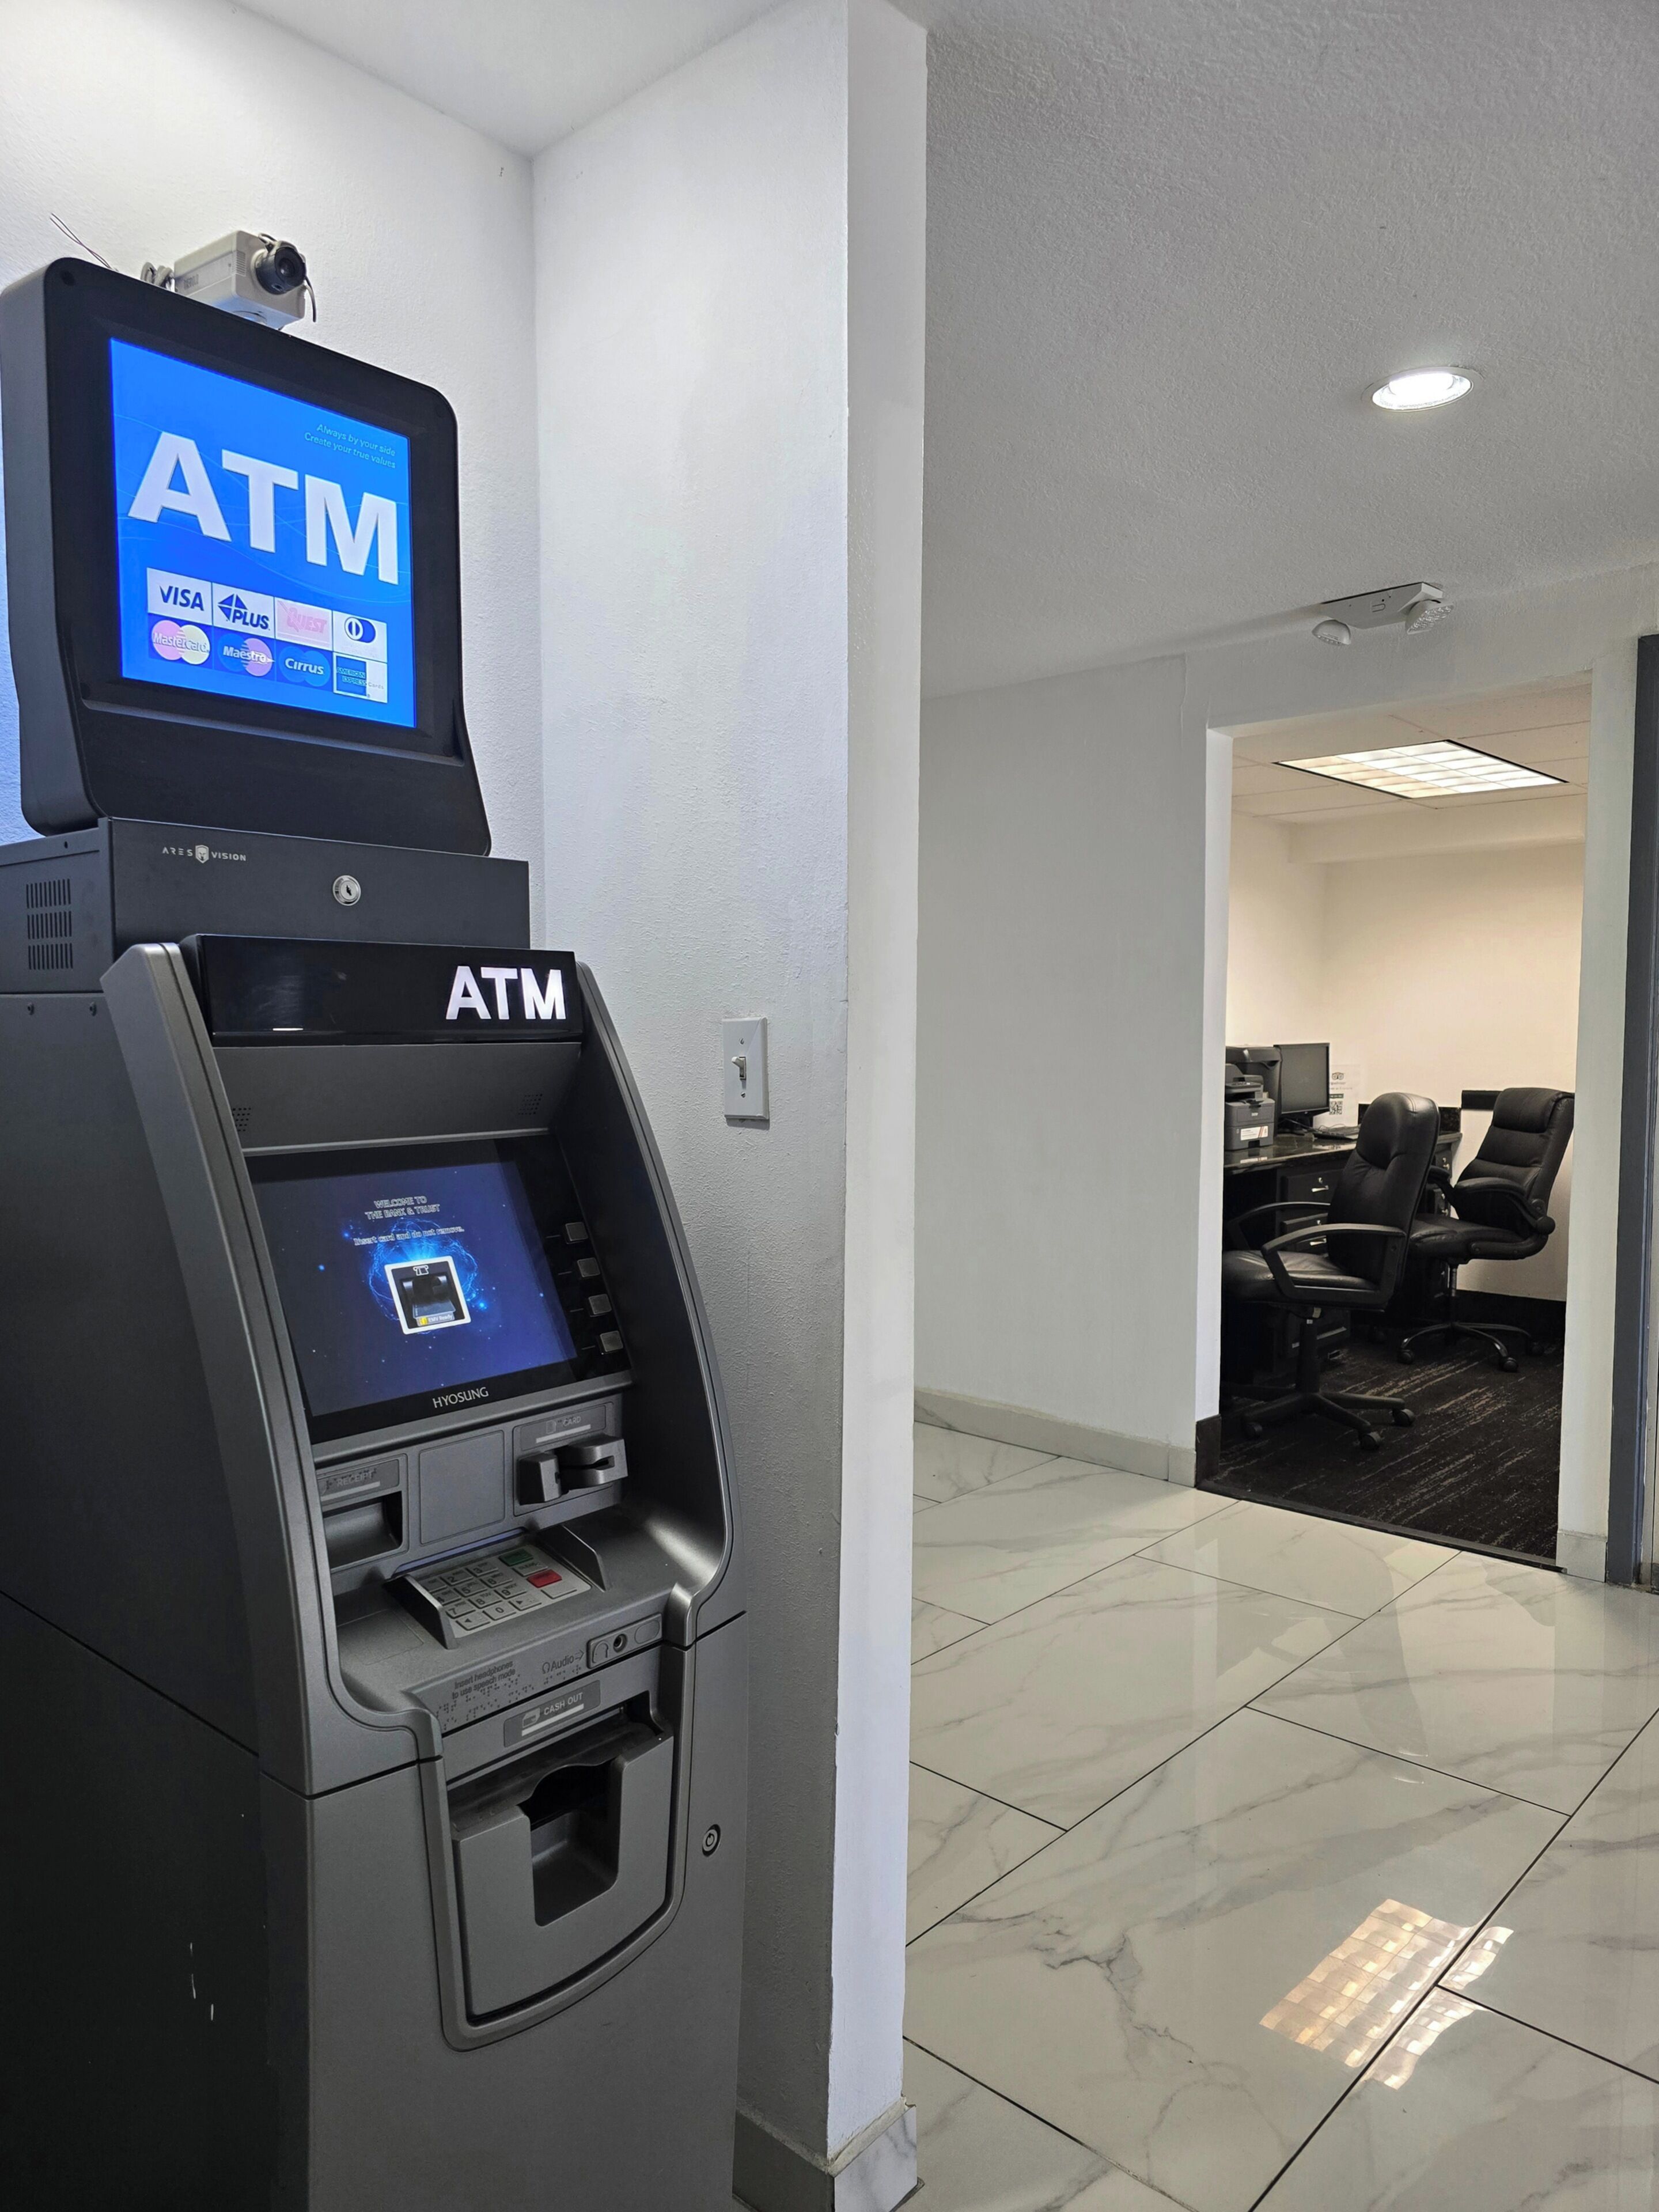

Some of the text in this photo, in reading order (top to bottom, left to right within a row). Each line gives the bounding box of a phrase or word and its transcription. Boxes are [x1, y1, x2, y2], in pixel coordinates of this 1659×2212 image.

[317, 424, 396, 456] Always by your side
[304, 433, 396, 468] Create your true values
[128, 431, 399, 585] ATM
[159, 585, 204, 611] VISA
[232, 609, 270, 630] PLUS
[223, 646, 268, 664] Maestro
[285, 658, 324, 675] Cirrus
[337, 667, 366, 679] AMERICAN
[342, 676, 368, 687] EXPRESS
[162, 847, 247, 861] ARES VISION
[445, 965, 566, 1020] ATM
[374, 1196, 427, 1209] WELCOME TO
[365, 1204, 440, 1220] THE BANK & TRUST
[412, 1230, 422, 1238] do
[432, 1387, 489, 1408] HYOSUNG
[563, 1416, 581, 1426] CARD
[336, 1471, 374, 1486] RECEIPT
[551, 1655, 574, 1671] Audio
[452, 1668, 516, 1699] to use speech mode
[454, 1661, 513, 1689] Insert headphones
[544, 1692, 584, 1715] CASH OUT
